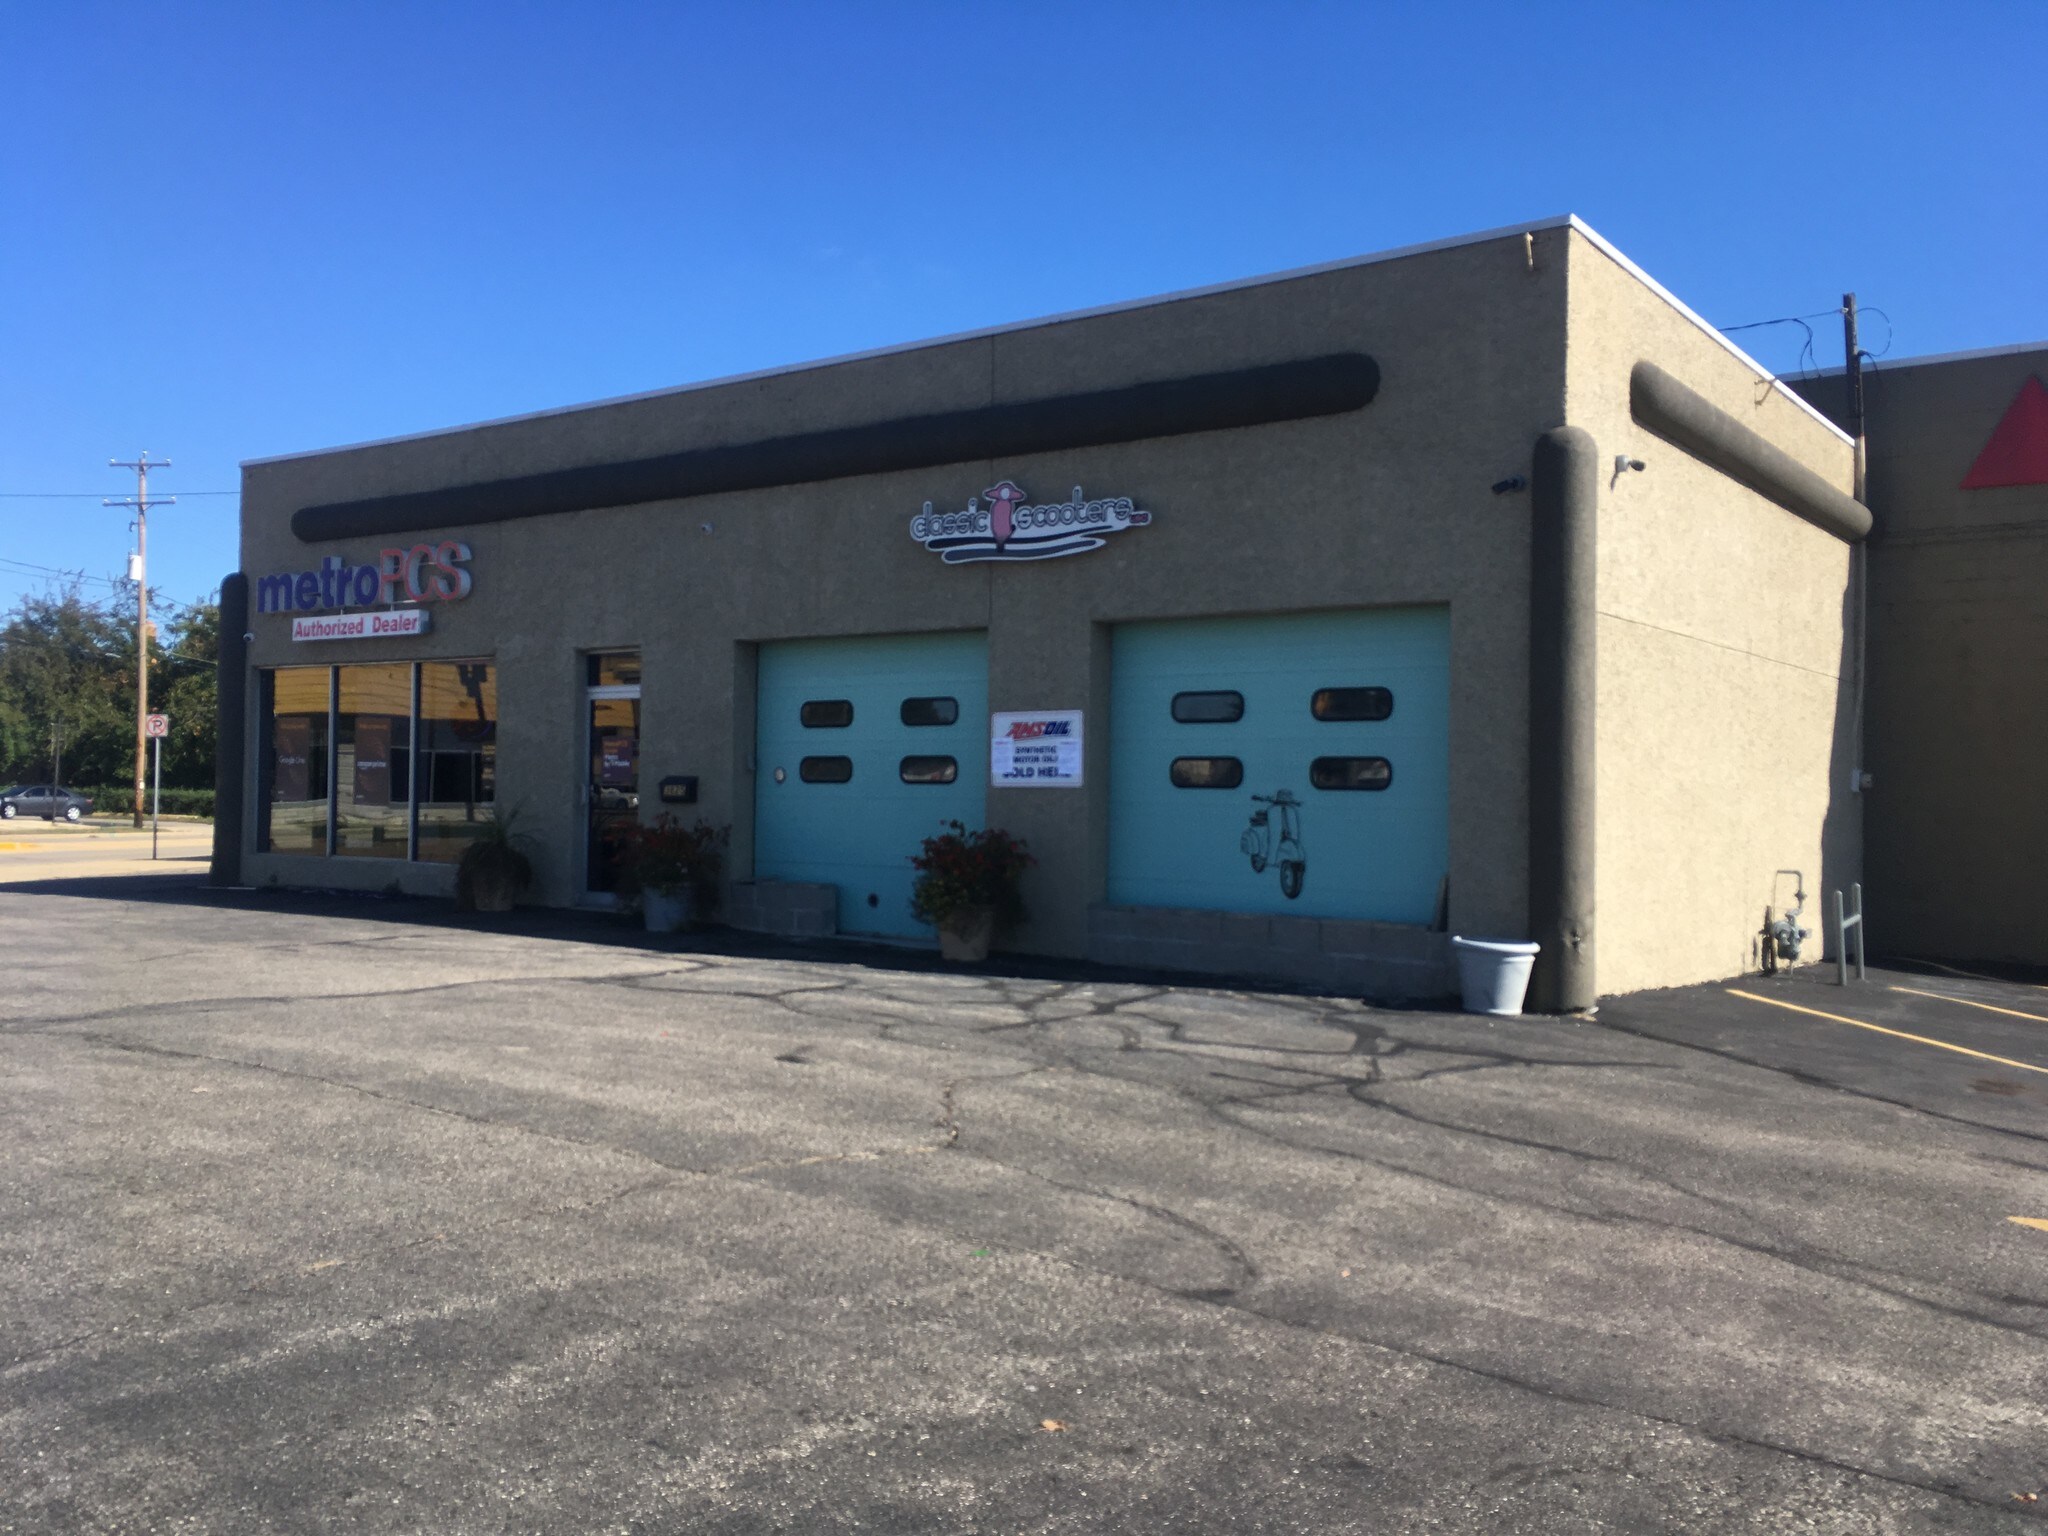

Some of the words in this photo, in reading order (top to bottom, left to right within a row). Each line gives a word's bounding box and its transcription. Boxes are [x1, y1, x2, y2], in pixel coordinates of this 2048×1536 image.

[911, 501, 988, 537] classic
[1015, 487, 1131, 530] scooters
[257, 541, 471, 613] metroPCS
[294, 617, 364, 638] Authorized
[371, 614, 418, 634] Dealer
[1005, 720, 1071, 739] AMSOIL
